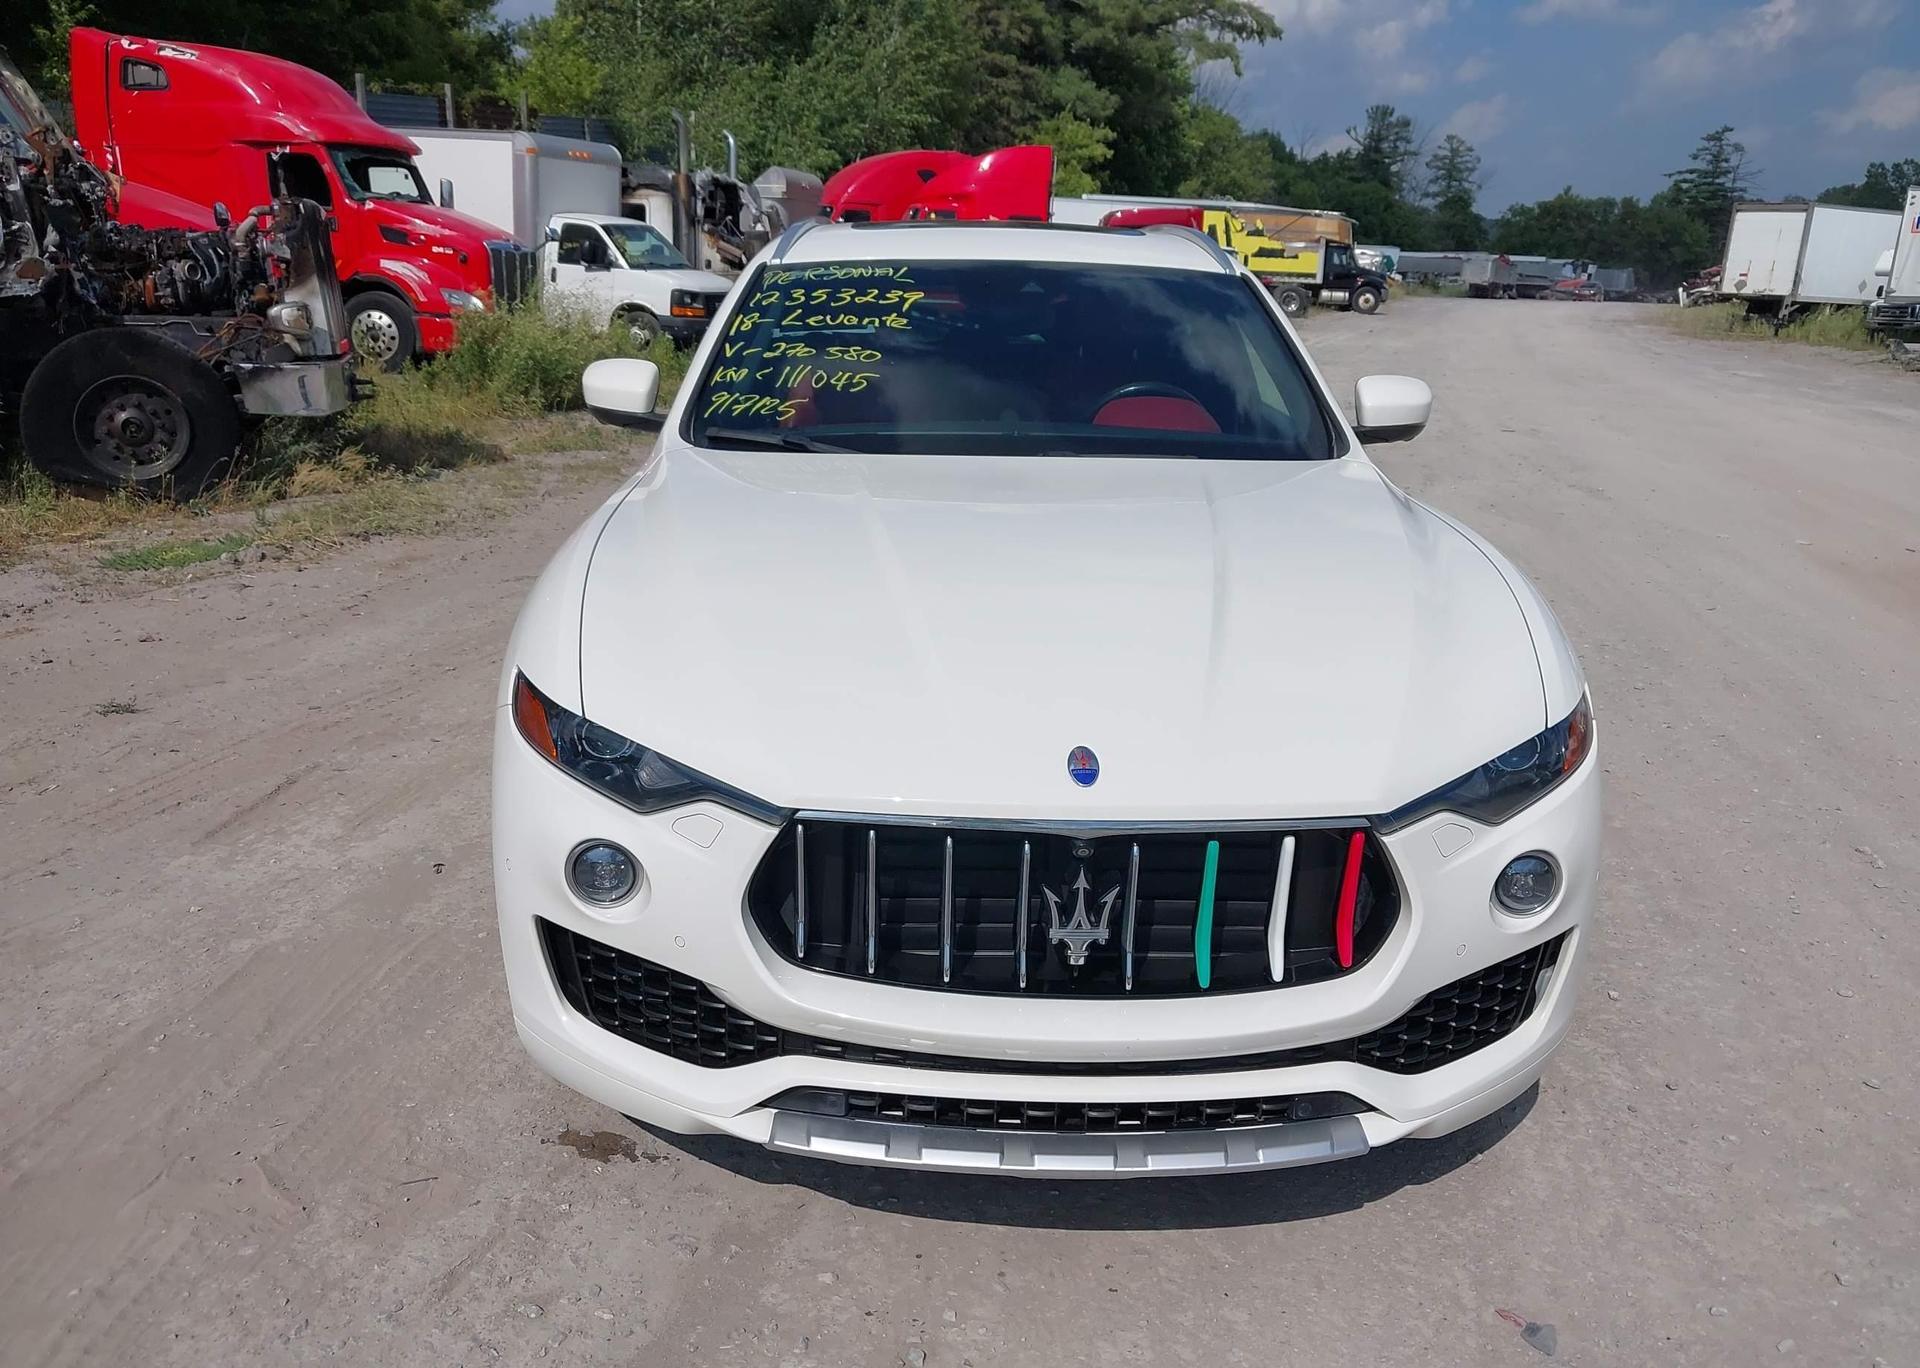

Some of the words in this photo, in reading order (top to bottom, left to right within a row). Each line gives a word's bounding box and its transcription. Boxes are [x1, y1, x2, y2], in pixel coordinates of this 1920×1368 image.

[763, 266, 915, 289] PERSONAL
[750, 288, 925, 312] 12353239
[781, 309, 913, 330] Levante
[776, 364, 881, 392] 111045
